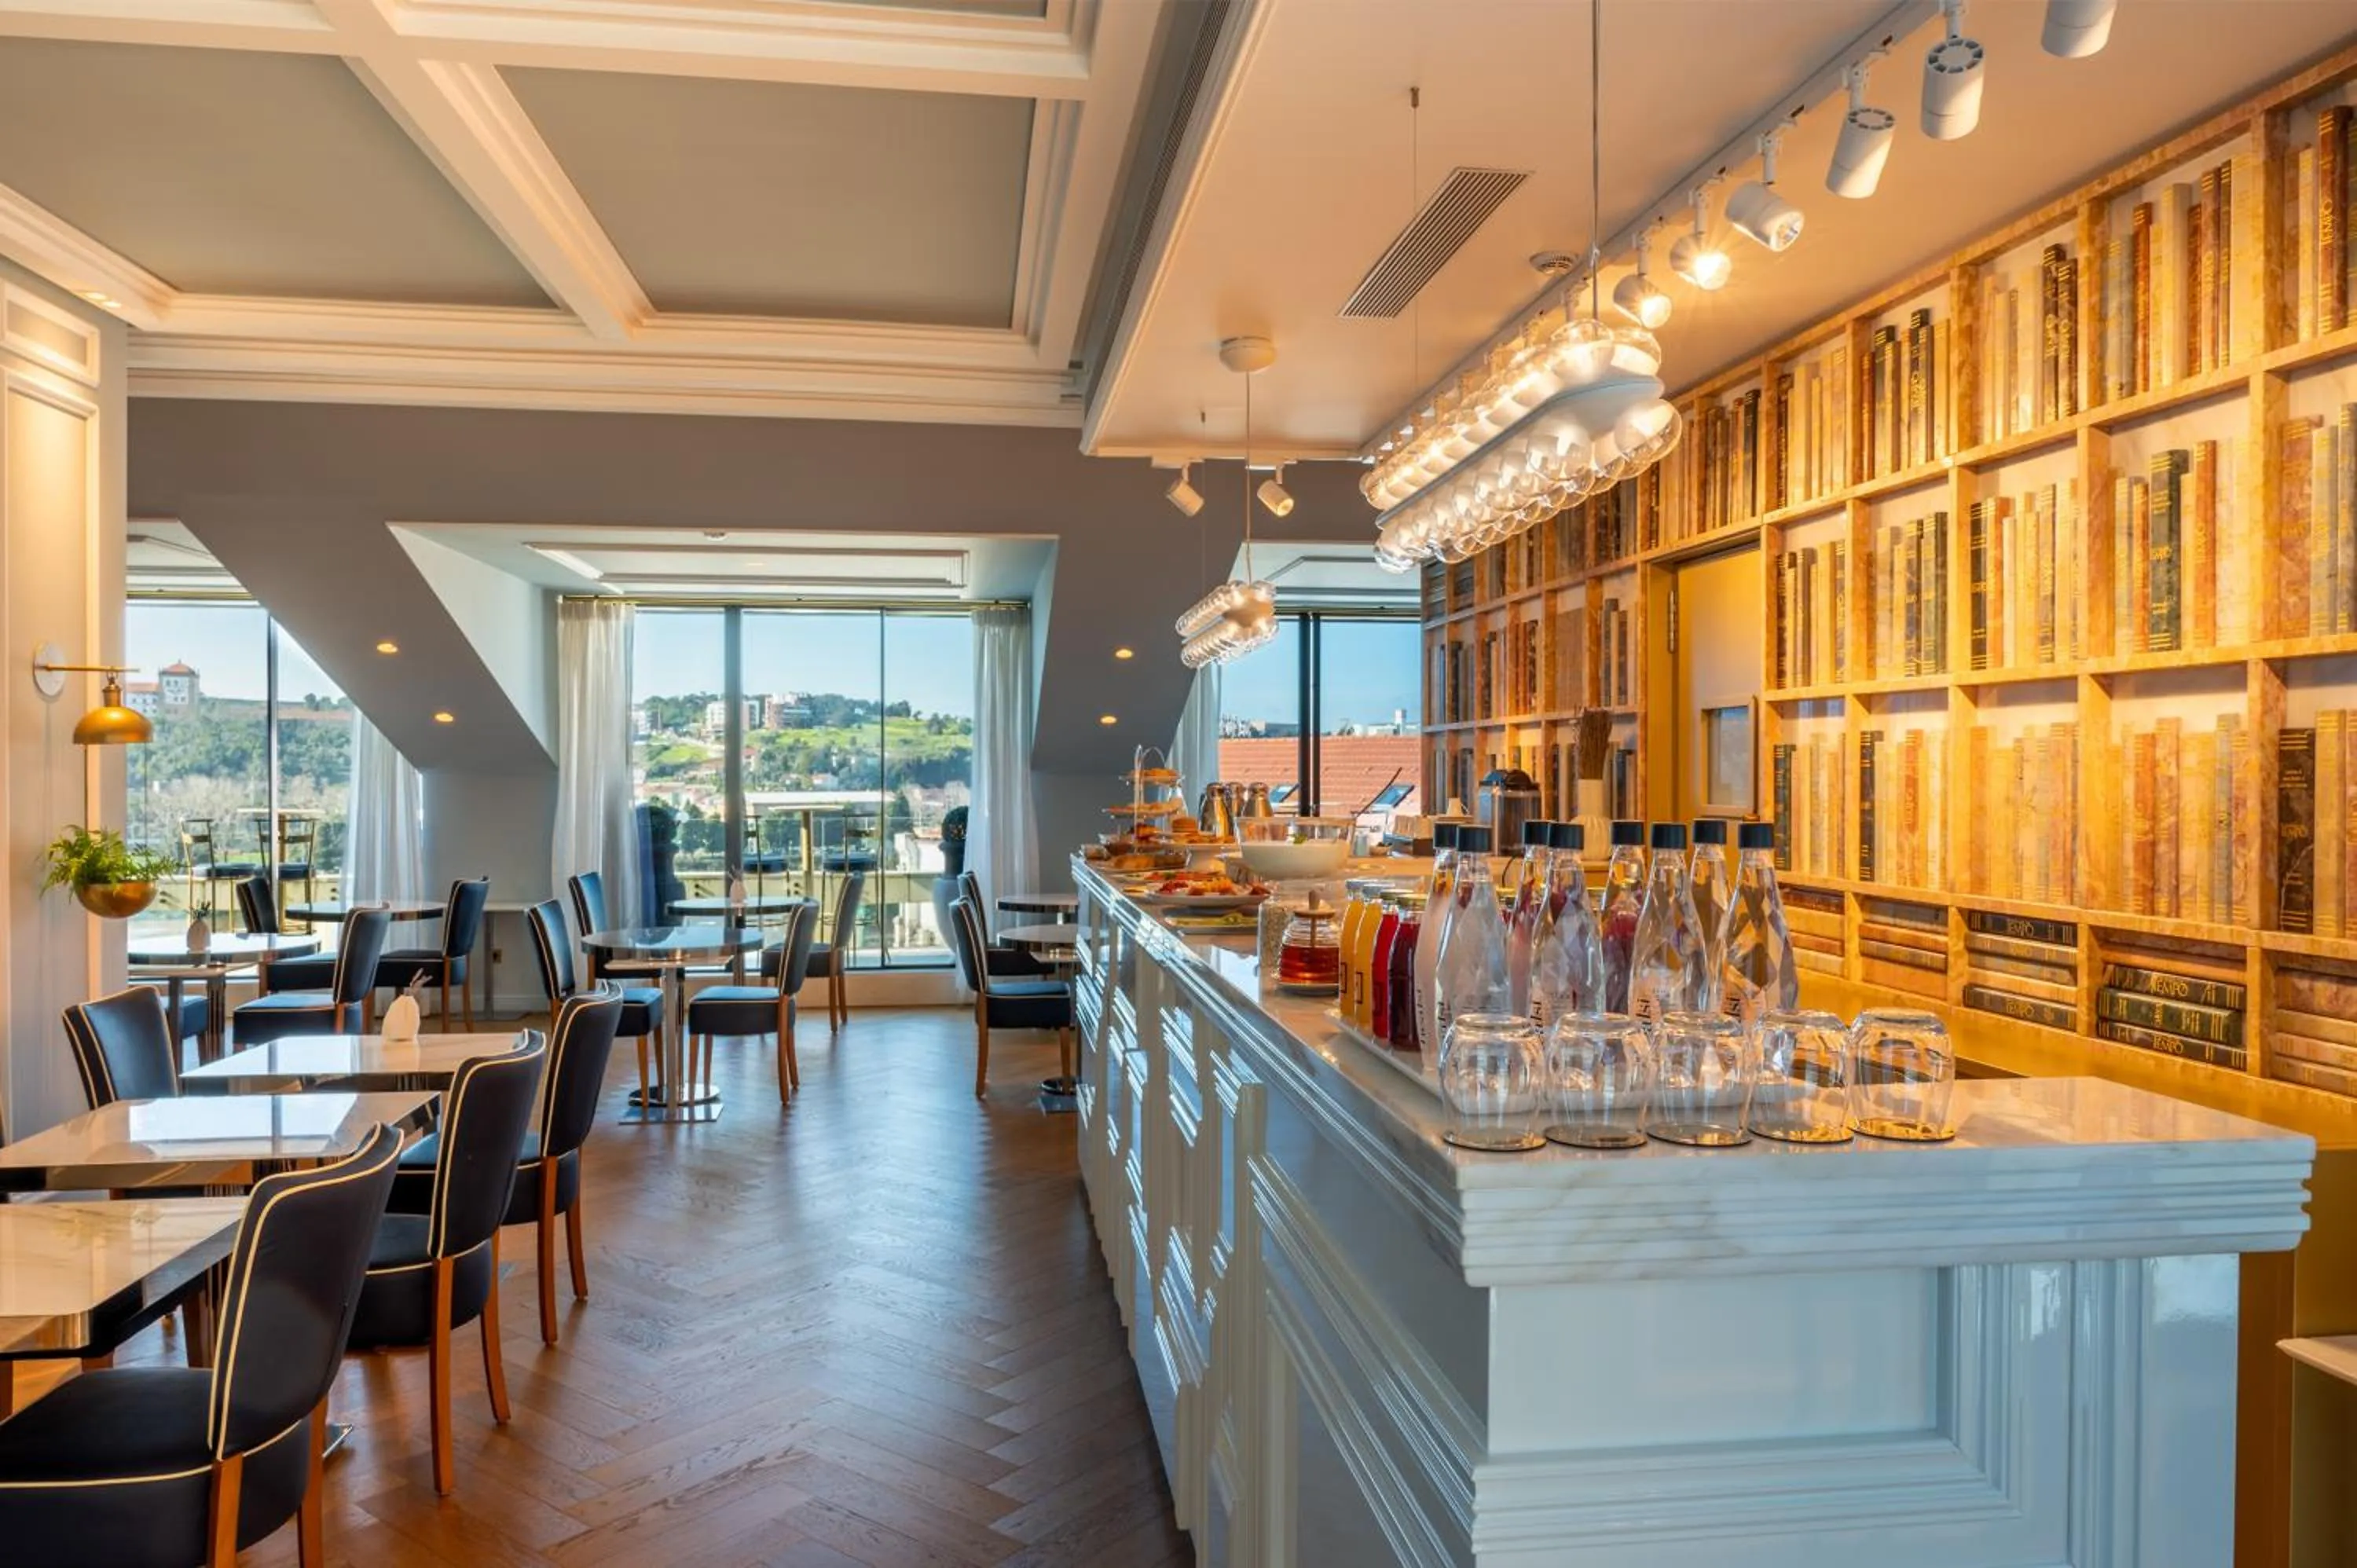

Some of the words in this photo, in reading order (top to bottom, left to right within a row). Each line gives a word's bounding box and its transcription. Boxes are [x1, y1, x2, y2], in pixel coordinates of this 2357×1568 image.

[2153, 976, 2189, 998] TEMPO
[2006, 998, 2035, 1019] TEMPO
[2153, 1034, 2185, 1055] TEMPO
